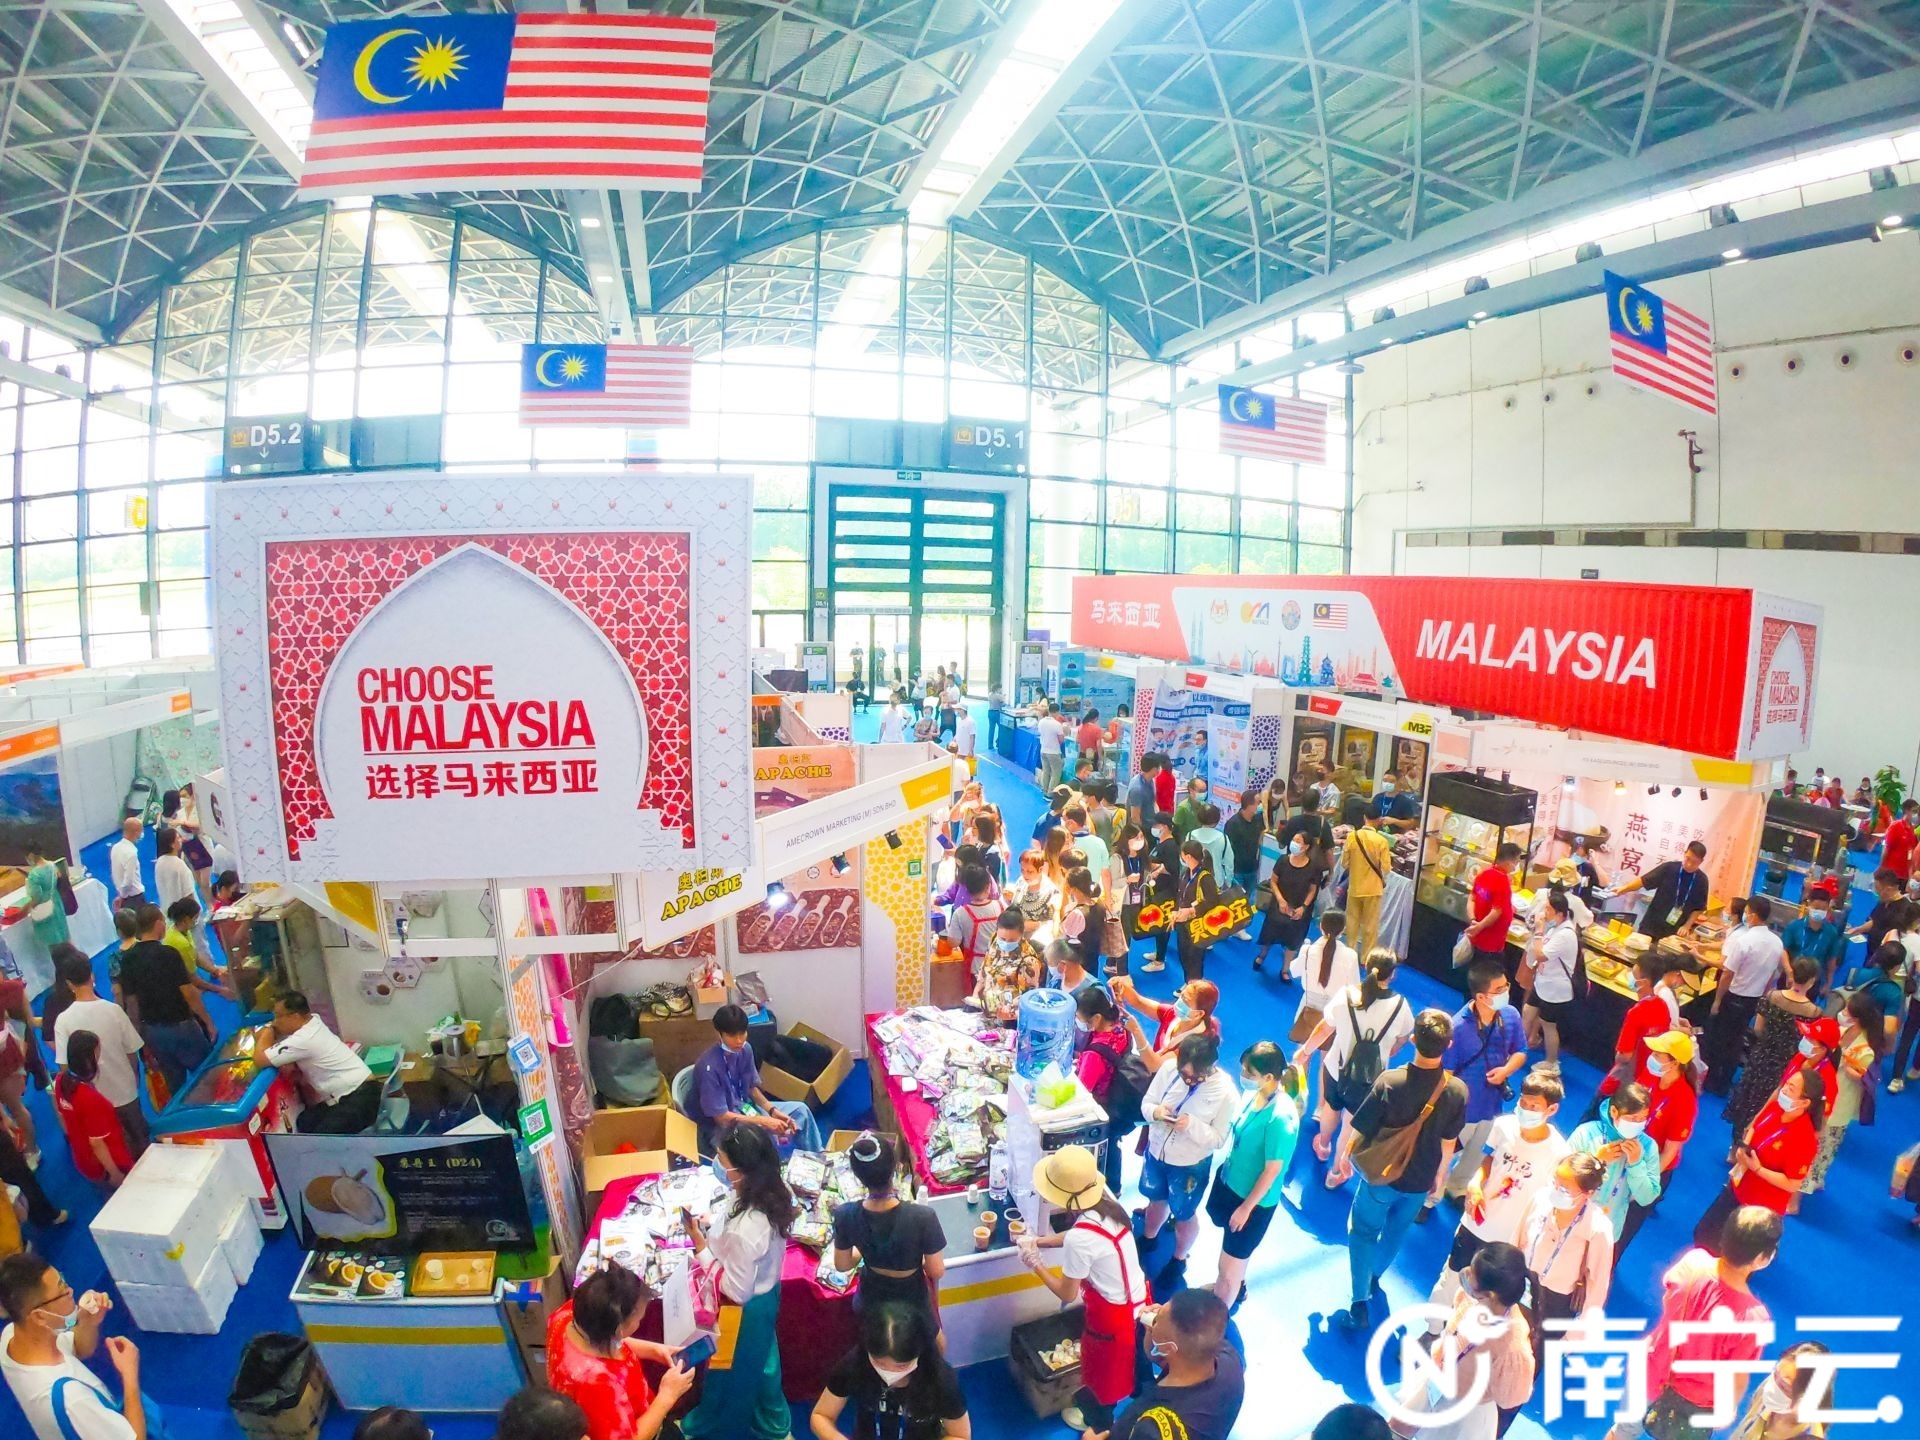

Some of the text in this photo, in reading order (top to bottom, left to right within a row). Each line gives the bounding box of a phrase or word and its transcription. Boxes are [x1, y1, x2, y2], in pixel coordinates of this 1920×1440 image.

[250, 423, 302, 447] D5.2
[975, 426, 1024, 449] D5.1
[1091, 599, 1160, 629] 马来西亚
[1416, 618, 1656, 689] MALAYSIA
[357, 665, 495, 704] CHOOSE
[1771, 670, 1790, 685] CHOOSE
[1769, 685, 1799, 705] MALAYSIA
[360, 700, 596, 752] MALAYSIA
[366, 759, 599, 801] 选择马来西亚
[754, 765, 832, 781] APACHE
[786, 827, 825, 849] AMECROWN
[826, 812, 862, 835] MARKETING
[1620, 812, 1649, 876] 燕窝
[661, 874, 742, 921] APACHE
[446, 1157, 481, 1169] (D24)
